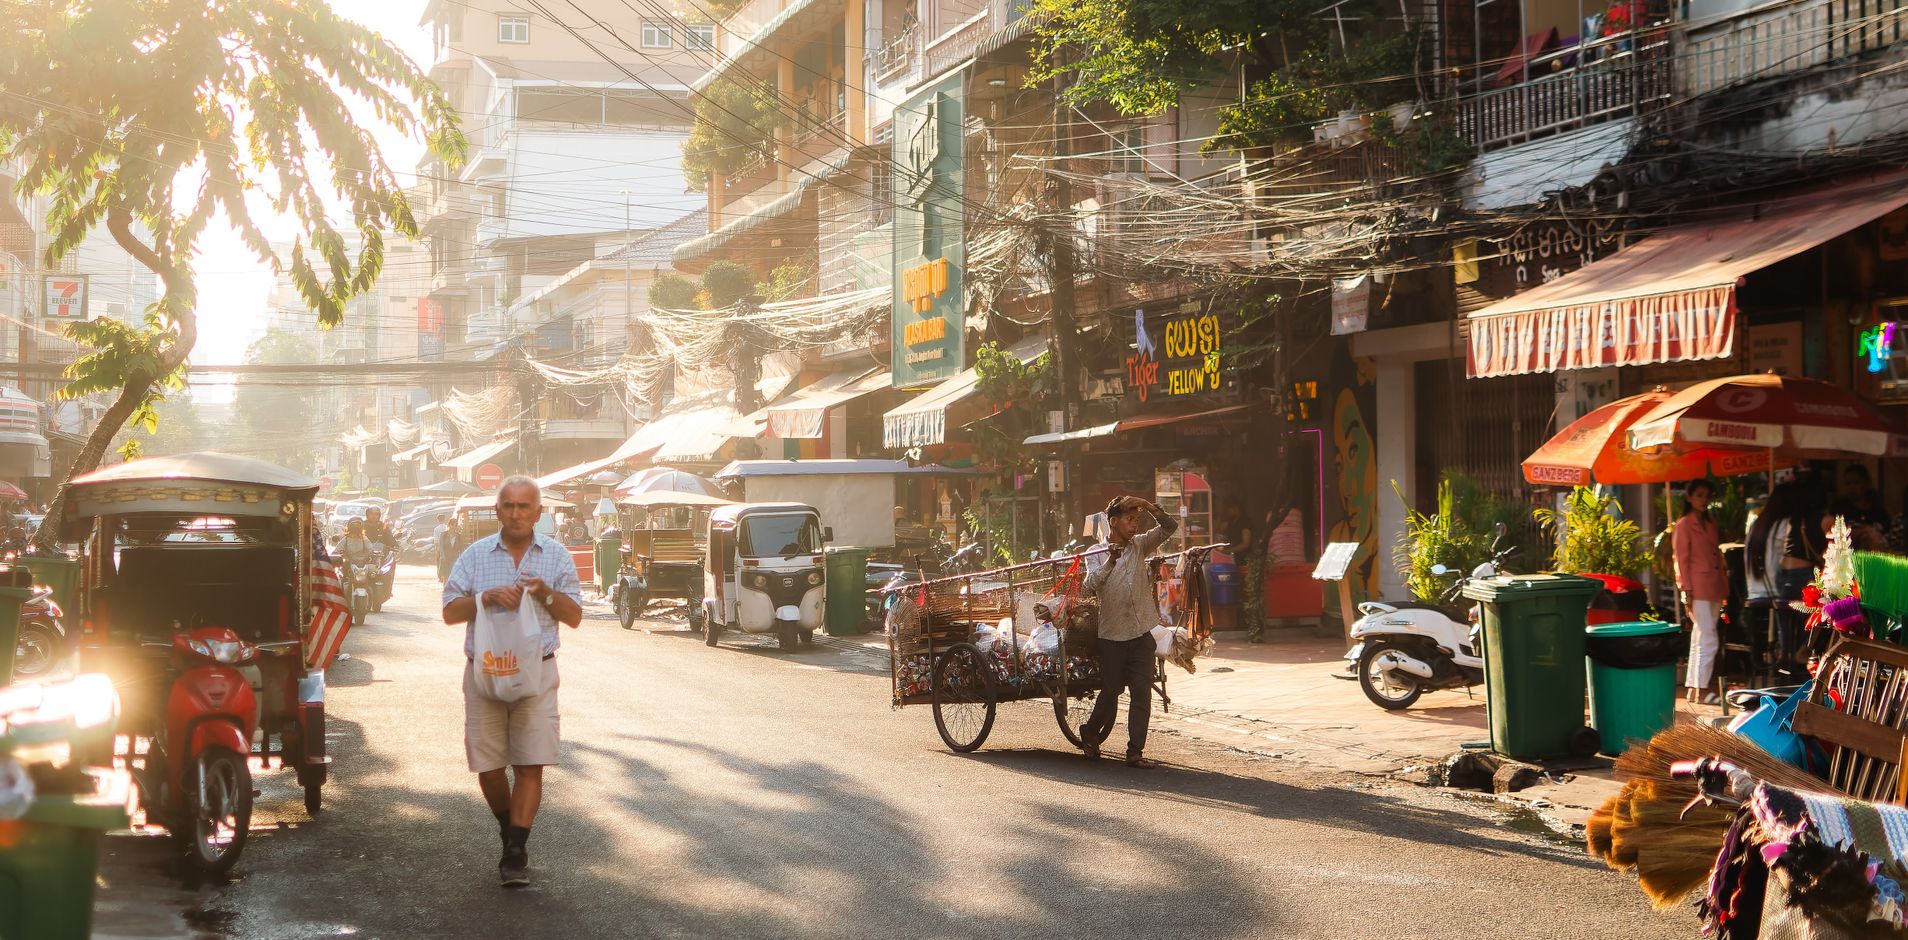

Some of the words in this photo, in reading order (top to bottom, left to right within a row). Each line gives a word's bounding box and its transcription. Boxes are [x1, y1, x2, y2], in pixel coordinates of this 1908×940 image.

[1126, 352, 1159, 402] Tiger
[1168, 367, 1204, 395] YELLOW
[1707, 422, 1757, 441] CAMBODIA
[483, 649, 517, 668] Smile
